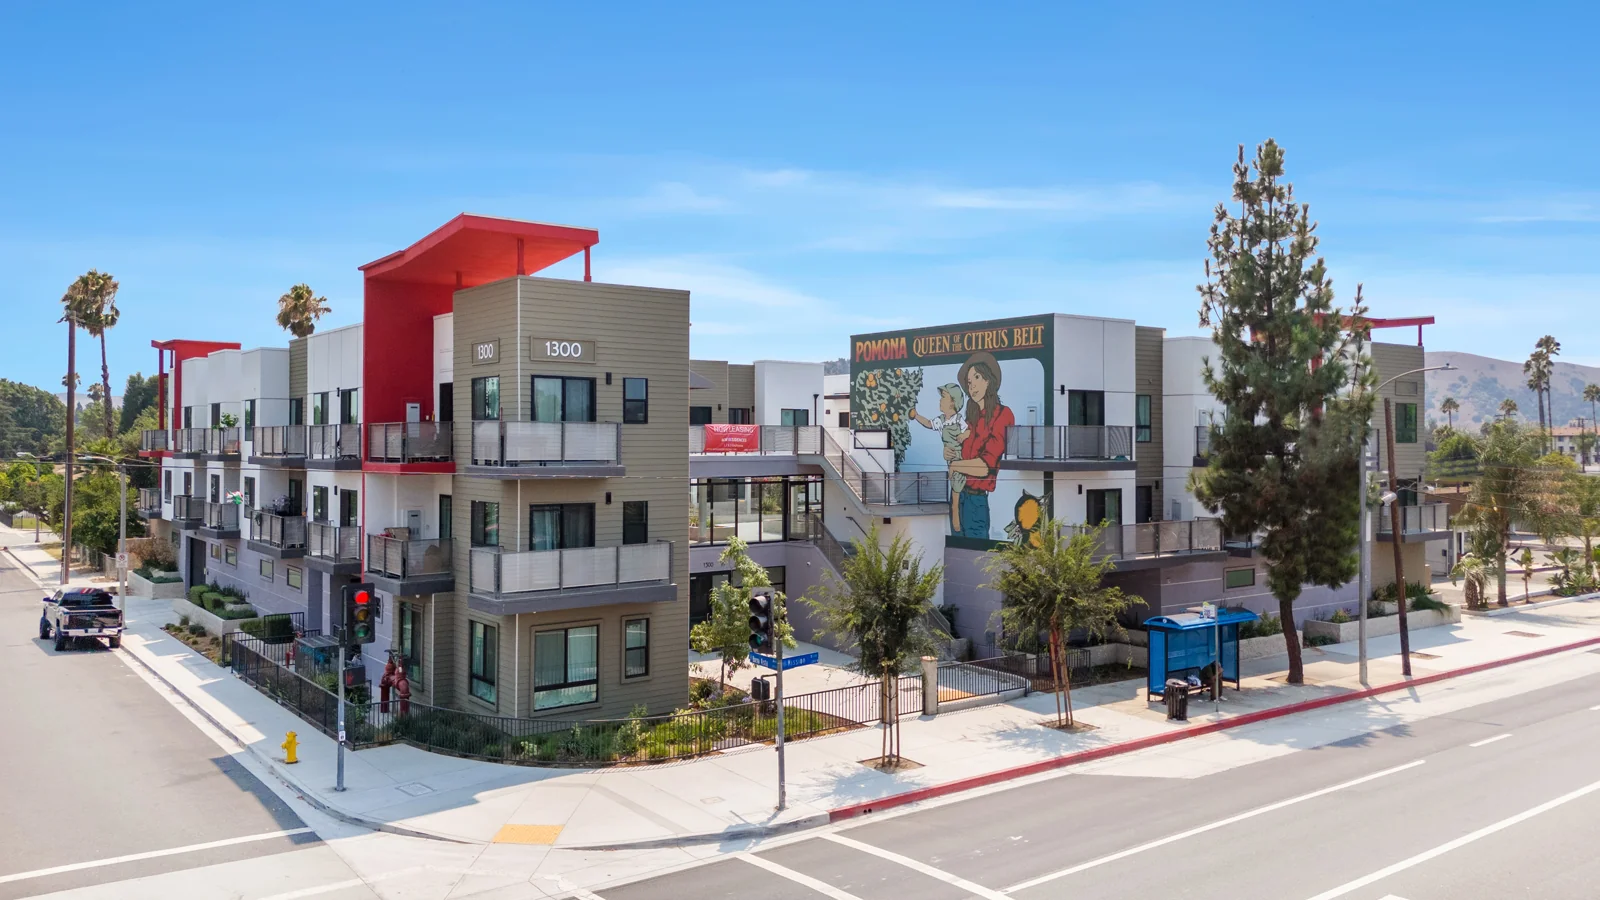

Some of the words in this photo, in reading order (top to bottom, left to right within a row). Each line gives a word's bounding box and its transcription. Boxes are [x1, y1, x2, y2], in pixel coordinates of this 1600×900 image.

[953, 335, 961, 343] OF
[964, 329, 1008, 351] CITRUS
[1013, 325, 1044, 347] BELT
[478, 344, 493, 359] 1300
[545, 341, 581, 357] 1300
[856, 337, 907, 362] POMONA
[913, 336, 950, 358] QUEEN
[952, 344, 962, 352] THE
